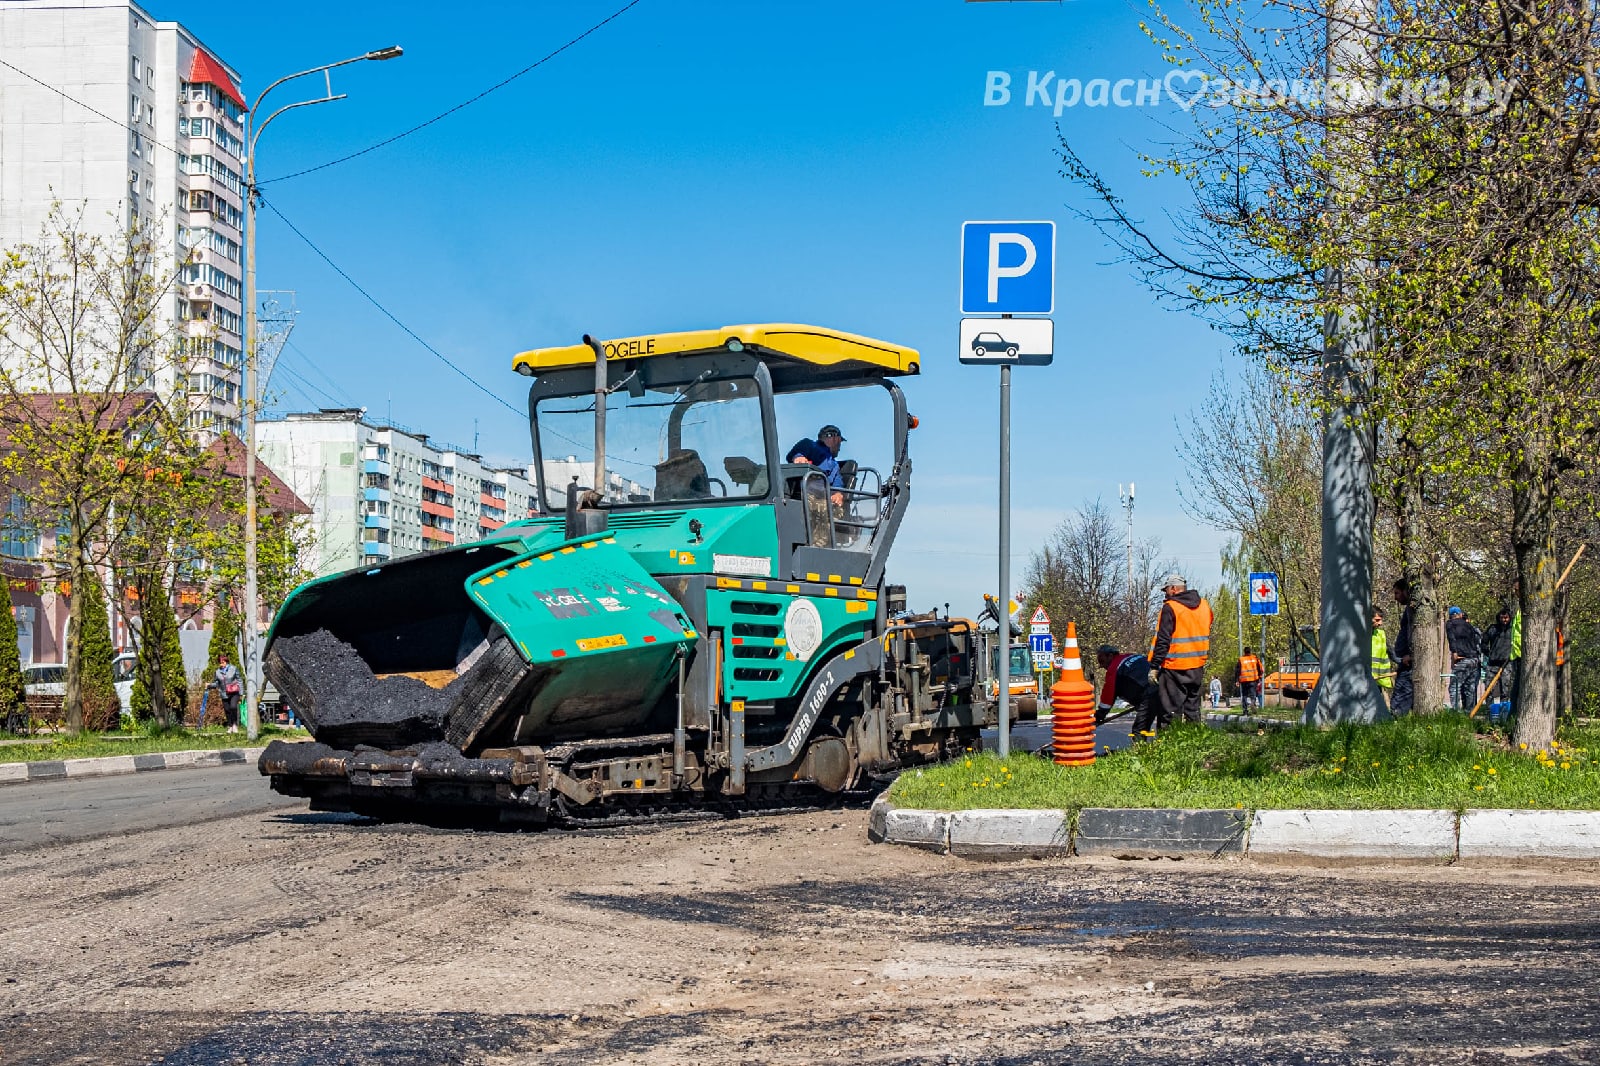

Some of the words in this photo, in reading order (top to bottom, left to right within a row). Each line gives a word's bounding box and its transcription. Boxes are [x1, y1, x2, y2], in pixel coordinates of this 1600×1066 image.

[988, 233, 1037, 303] P
[602, 339, 656, 359] ÖGELE
[788, 712, 812, 755] SUPER
[809, 671, 835, 715] 1600-2
